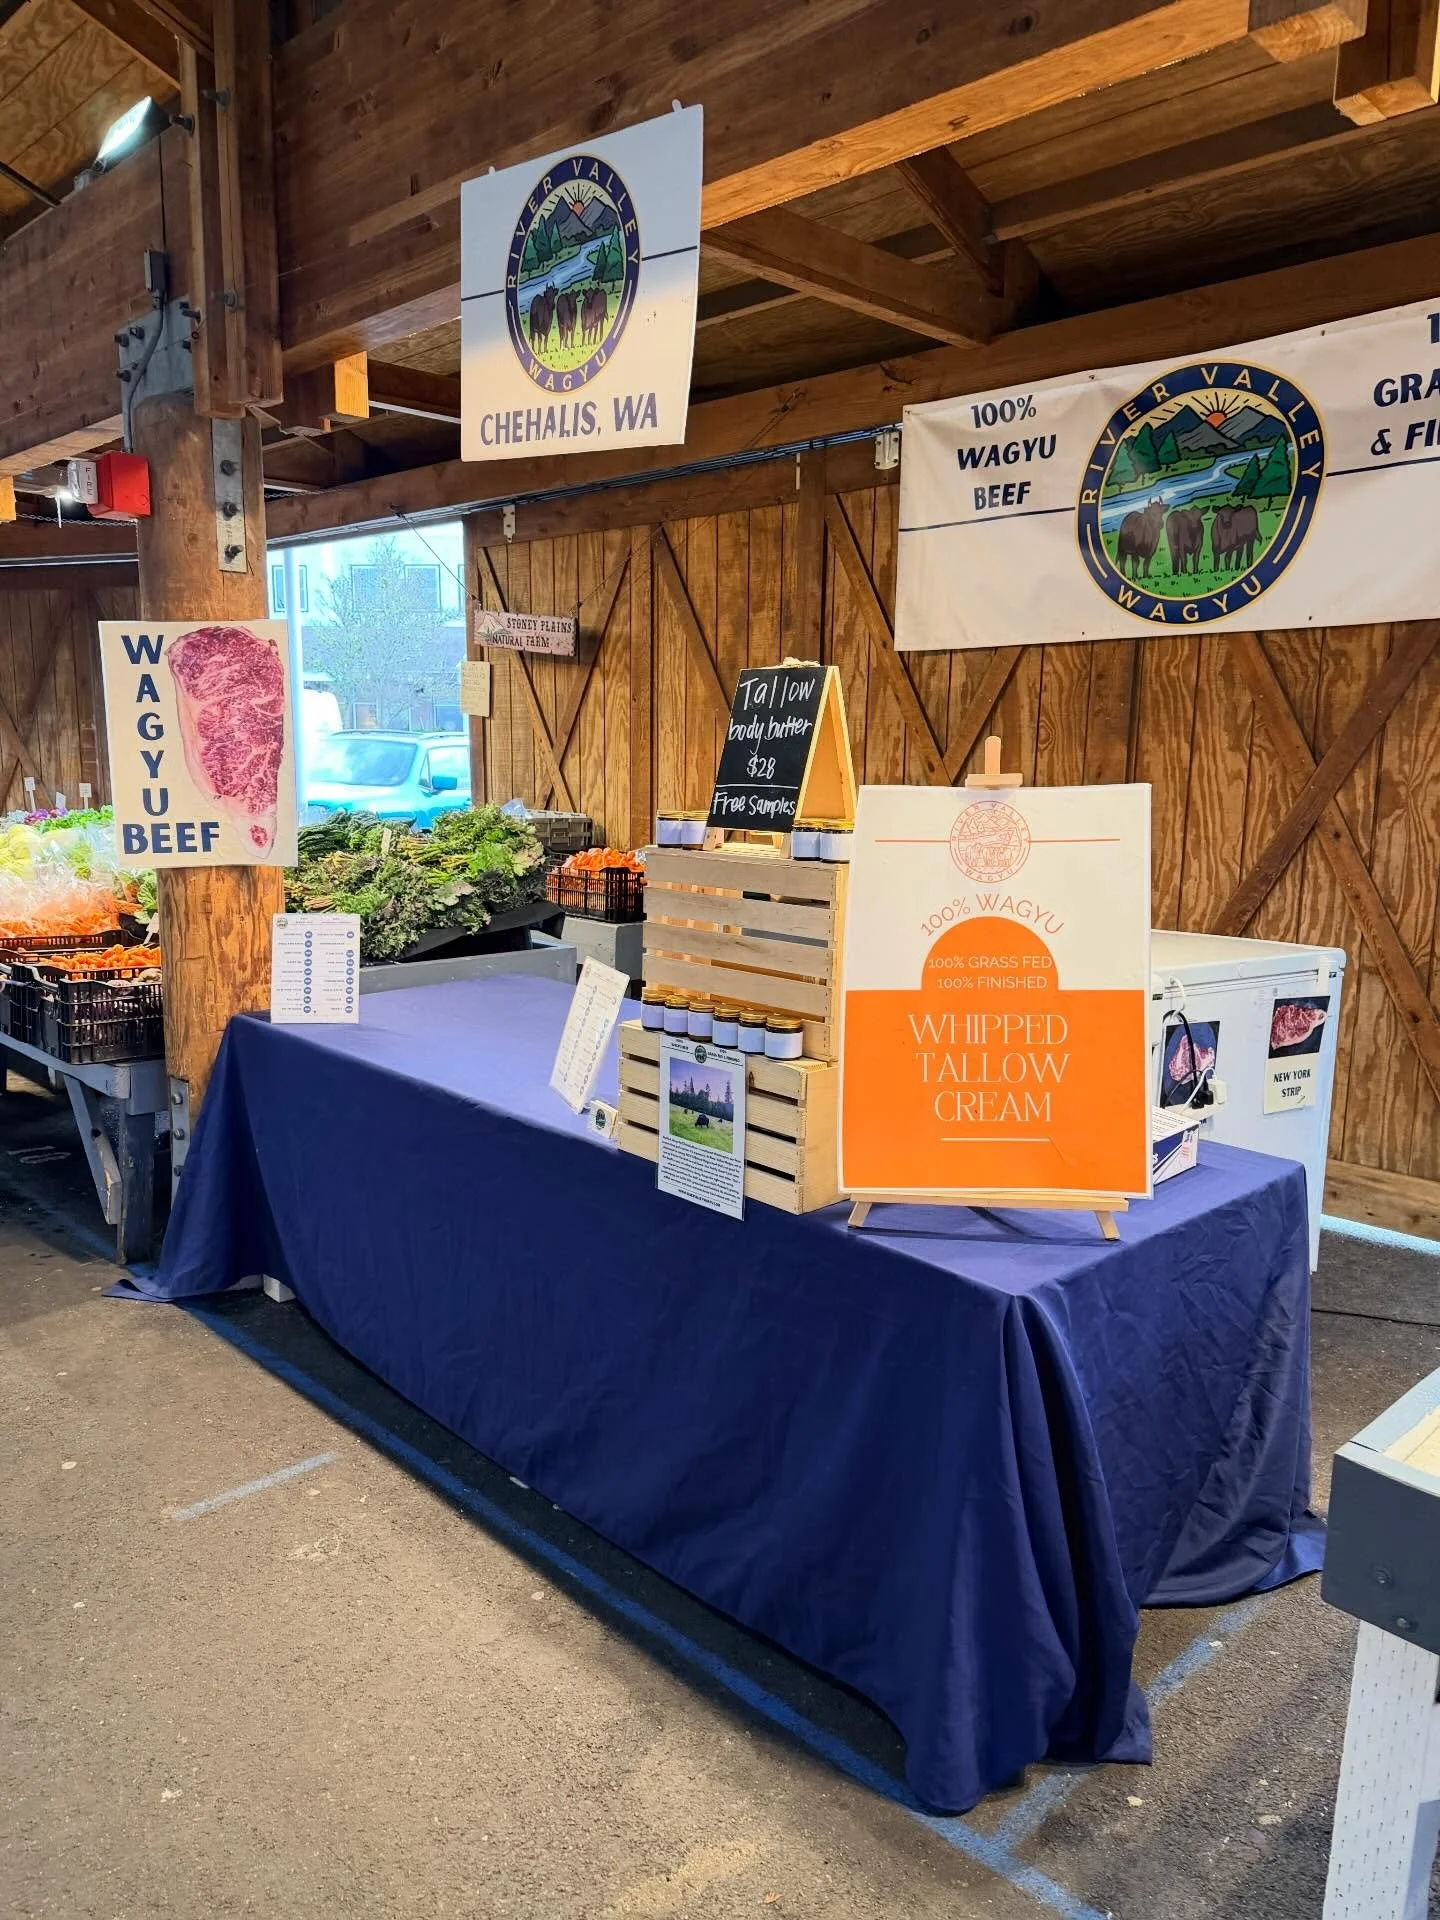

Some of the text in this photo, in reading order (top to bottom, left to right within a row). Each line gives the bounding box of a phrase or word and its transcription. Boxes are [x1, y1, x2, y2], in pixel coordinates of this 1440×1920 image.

[507, 159, 639, 289] RIVER VALLEY
[528, 349, 608, 390] WAGYU
[480, 392, 658, 446] CHEHALIS, WA
[970, 394, 1037, 429] 100%
[1082, 365, 1321, 505] RIVER VALLEY
[1370, 428, 1392, 456] &
[957, 433, 1057, 471] WAGYU
[973, 481, 1032, 511] BEEF
[1117, 575, 1262, 622] WAGYU
[492, 635, 550, 648] NATURAL FARM
[506, 617, 572, 634] STONEY PLAINS
[739, 675, 817, 711] Tallow
[120, 634, 169, 817] WAGYU
[728, 714, 812, 755] body butter
[746, 754, 777, 780] $28
[712, 791, 746, 816] Free
[122, 822, 220, 855] BEEF
[920, 893, 1065, 937] 100% WAGYU
[928, 955, 1053, 969] 100% GRASS FED
[937, 976, 1048, 990] 100% FINISHED
[907, 1014, 1069, 1045] WHIPPED
[915, 1052, 1071, 1084] TALLOW
[1273, 1068, 1312, 1083] NEW YORK
[934, 1090, 1052, 1122] CREAM
[1281, 1086, 1302, 1098] STRIP
